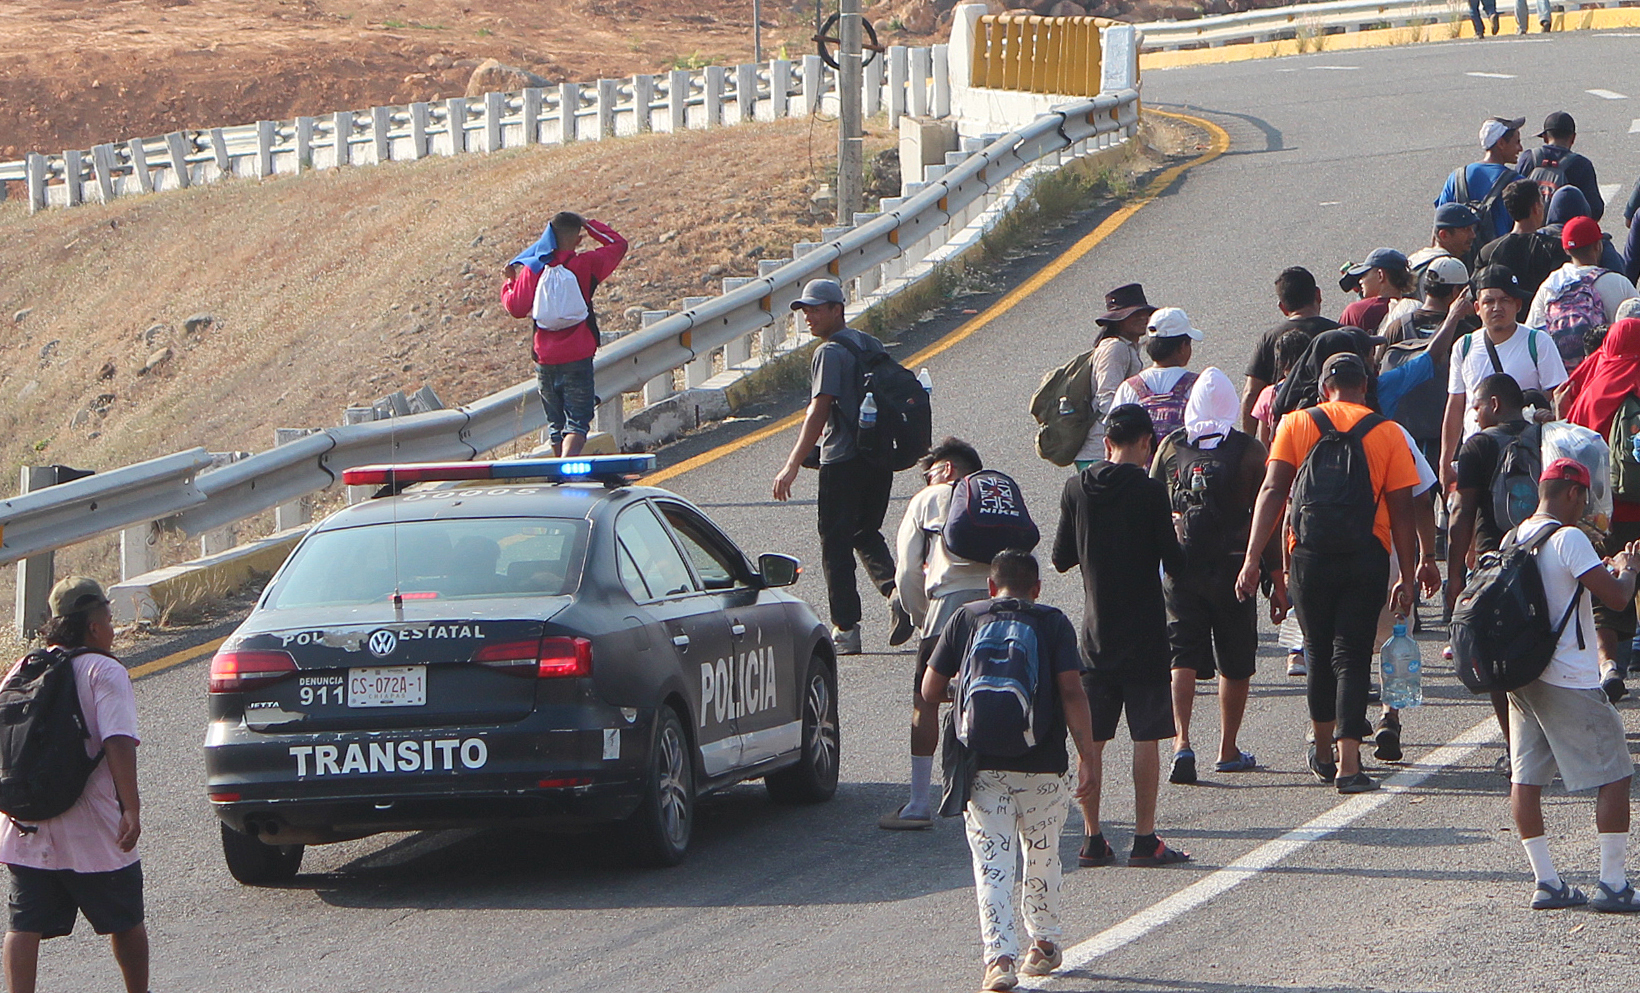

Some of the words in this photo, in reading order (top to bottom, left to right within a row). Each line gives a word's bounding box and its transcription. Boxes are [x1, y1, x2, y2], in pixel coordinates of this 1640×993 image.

[979, 507, 1020, 517] NIKE
[399, 625, 485, 641] ESTATAL
[300, 676, 344, 686] DENUNCIA
[351, 675, 422, 695] CS-072A-1
[300, 685, 344, 706] 911
[289, 737, 489, 777] TRANSITO
